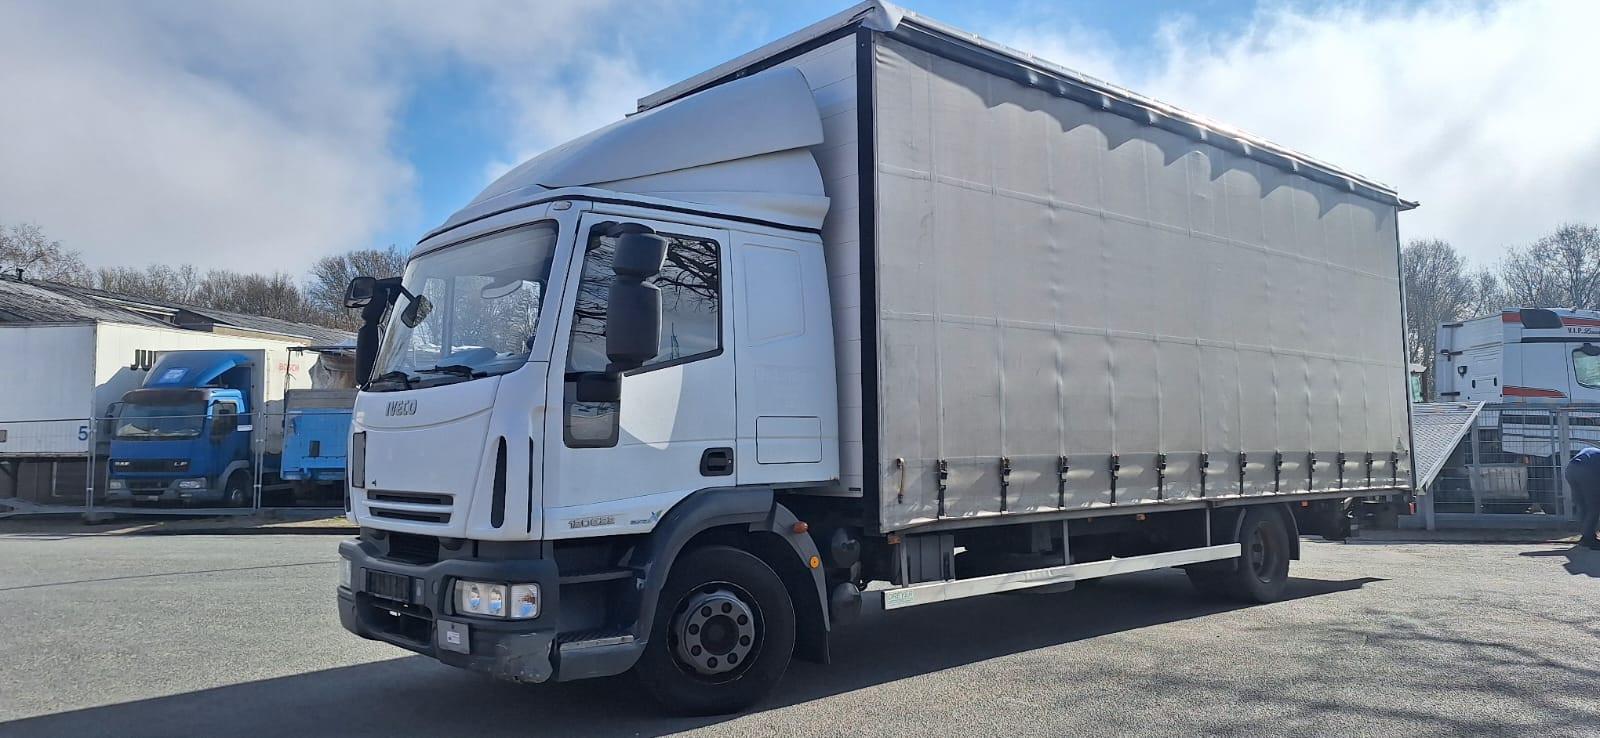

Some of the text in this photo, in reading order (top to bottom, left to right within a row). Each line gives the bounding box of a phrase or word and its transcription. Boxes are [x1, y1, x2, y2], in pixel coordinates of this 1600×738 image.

[130, 349, 157, 371] JU
[385, 399, 418, 416] IVECO
[78, 425, 88, 441] 5
